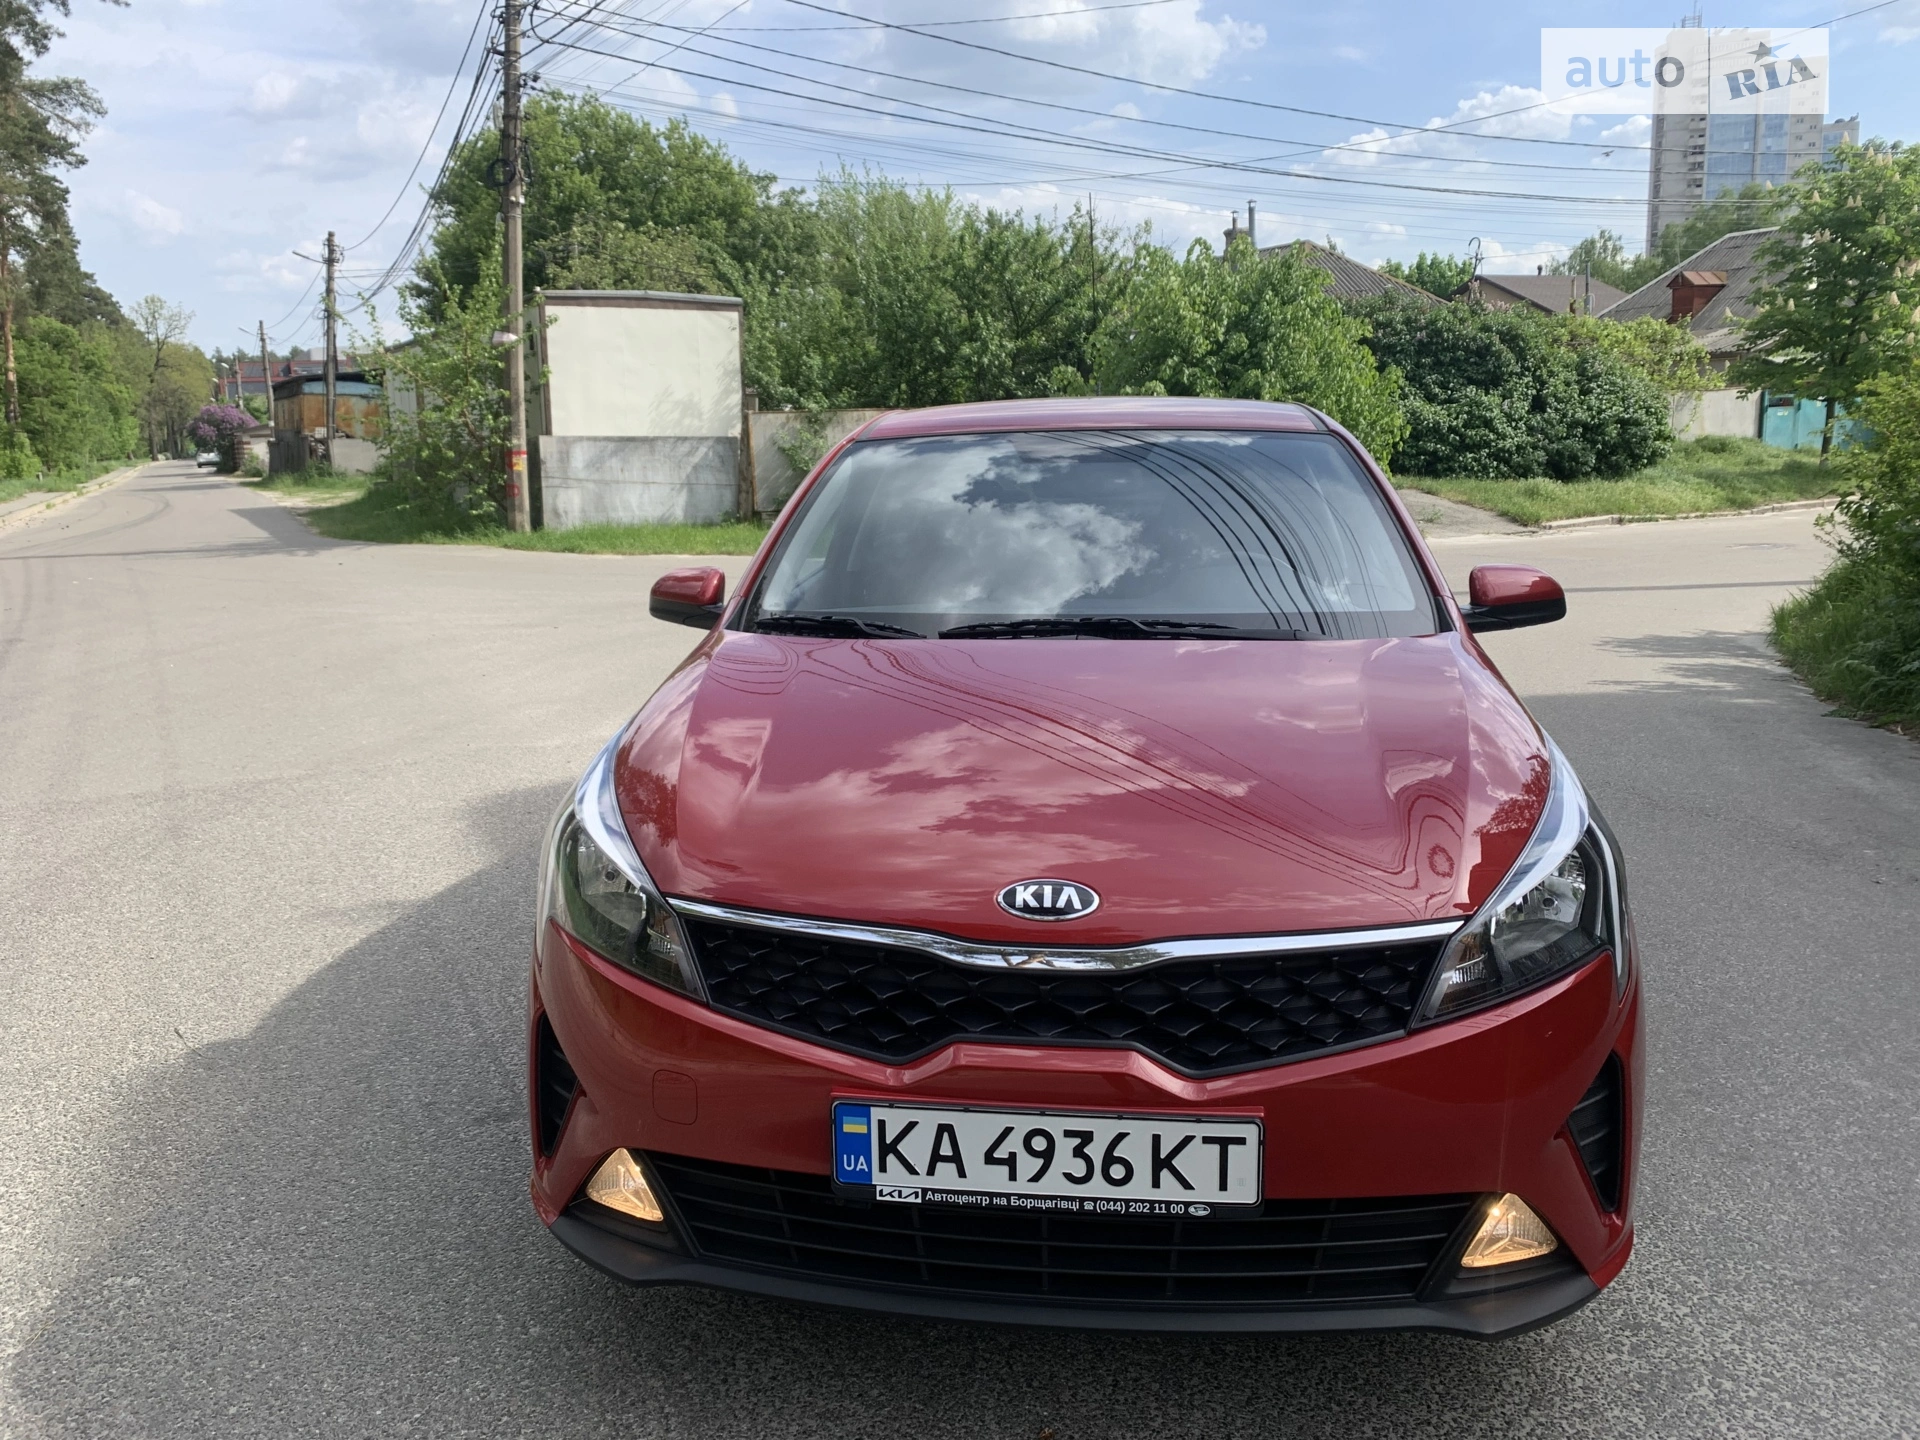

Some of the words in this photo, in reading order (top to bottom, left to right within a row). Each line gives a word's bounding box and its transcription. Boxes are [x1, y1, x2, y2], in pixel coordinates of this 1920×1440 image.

[1015, 885, 1082, 910] KIA
[843, 1154, 869, 1172] UA
[877, 1118, 967, 1178] KA
[984, 1125, 1135, 1187] 4936
[1151, 1133, 1247, 1191] KT
[926, 1191, 990, 1206] Автоцентр
[993, 1195, 1008, 1206] на
[1010, 1195, 1080, 1211] Борщагівці
[1096, 1200, 1126, 1214] (044)
[1128, 1202, 1150, 1213] 202
[1153, 1203, 1167, 1213] 11
[1170, 1203, 1185, 1214] 00
